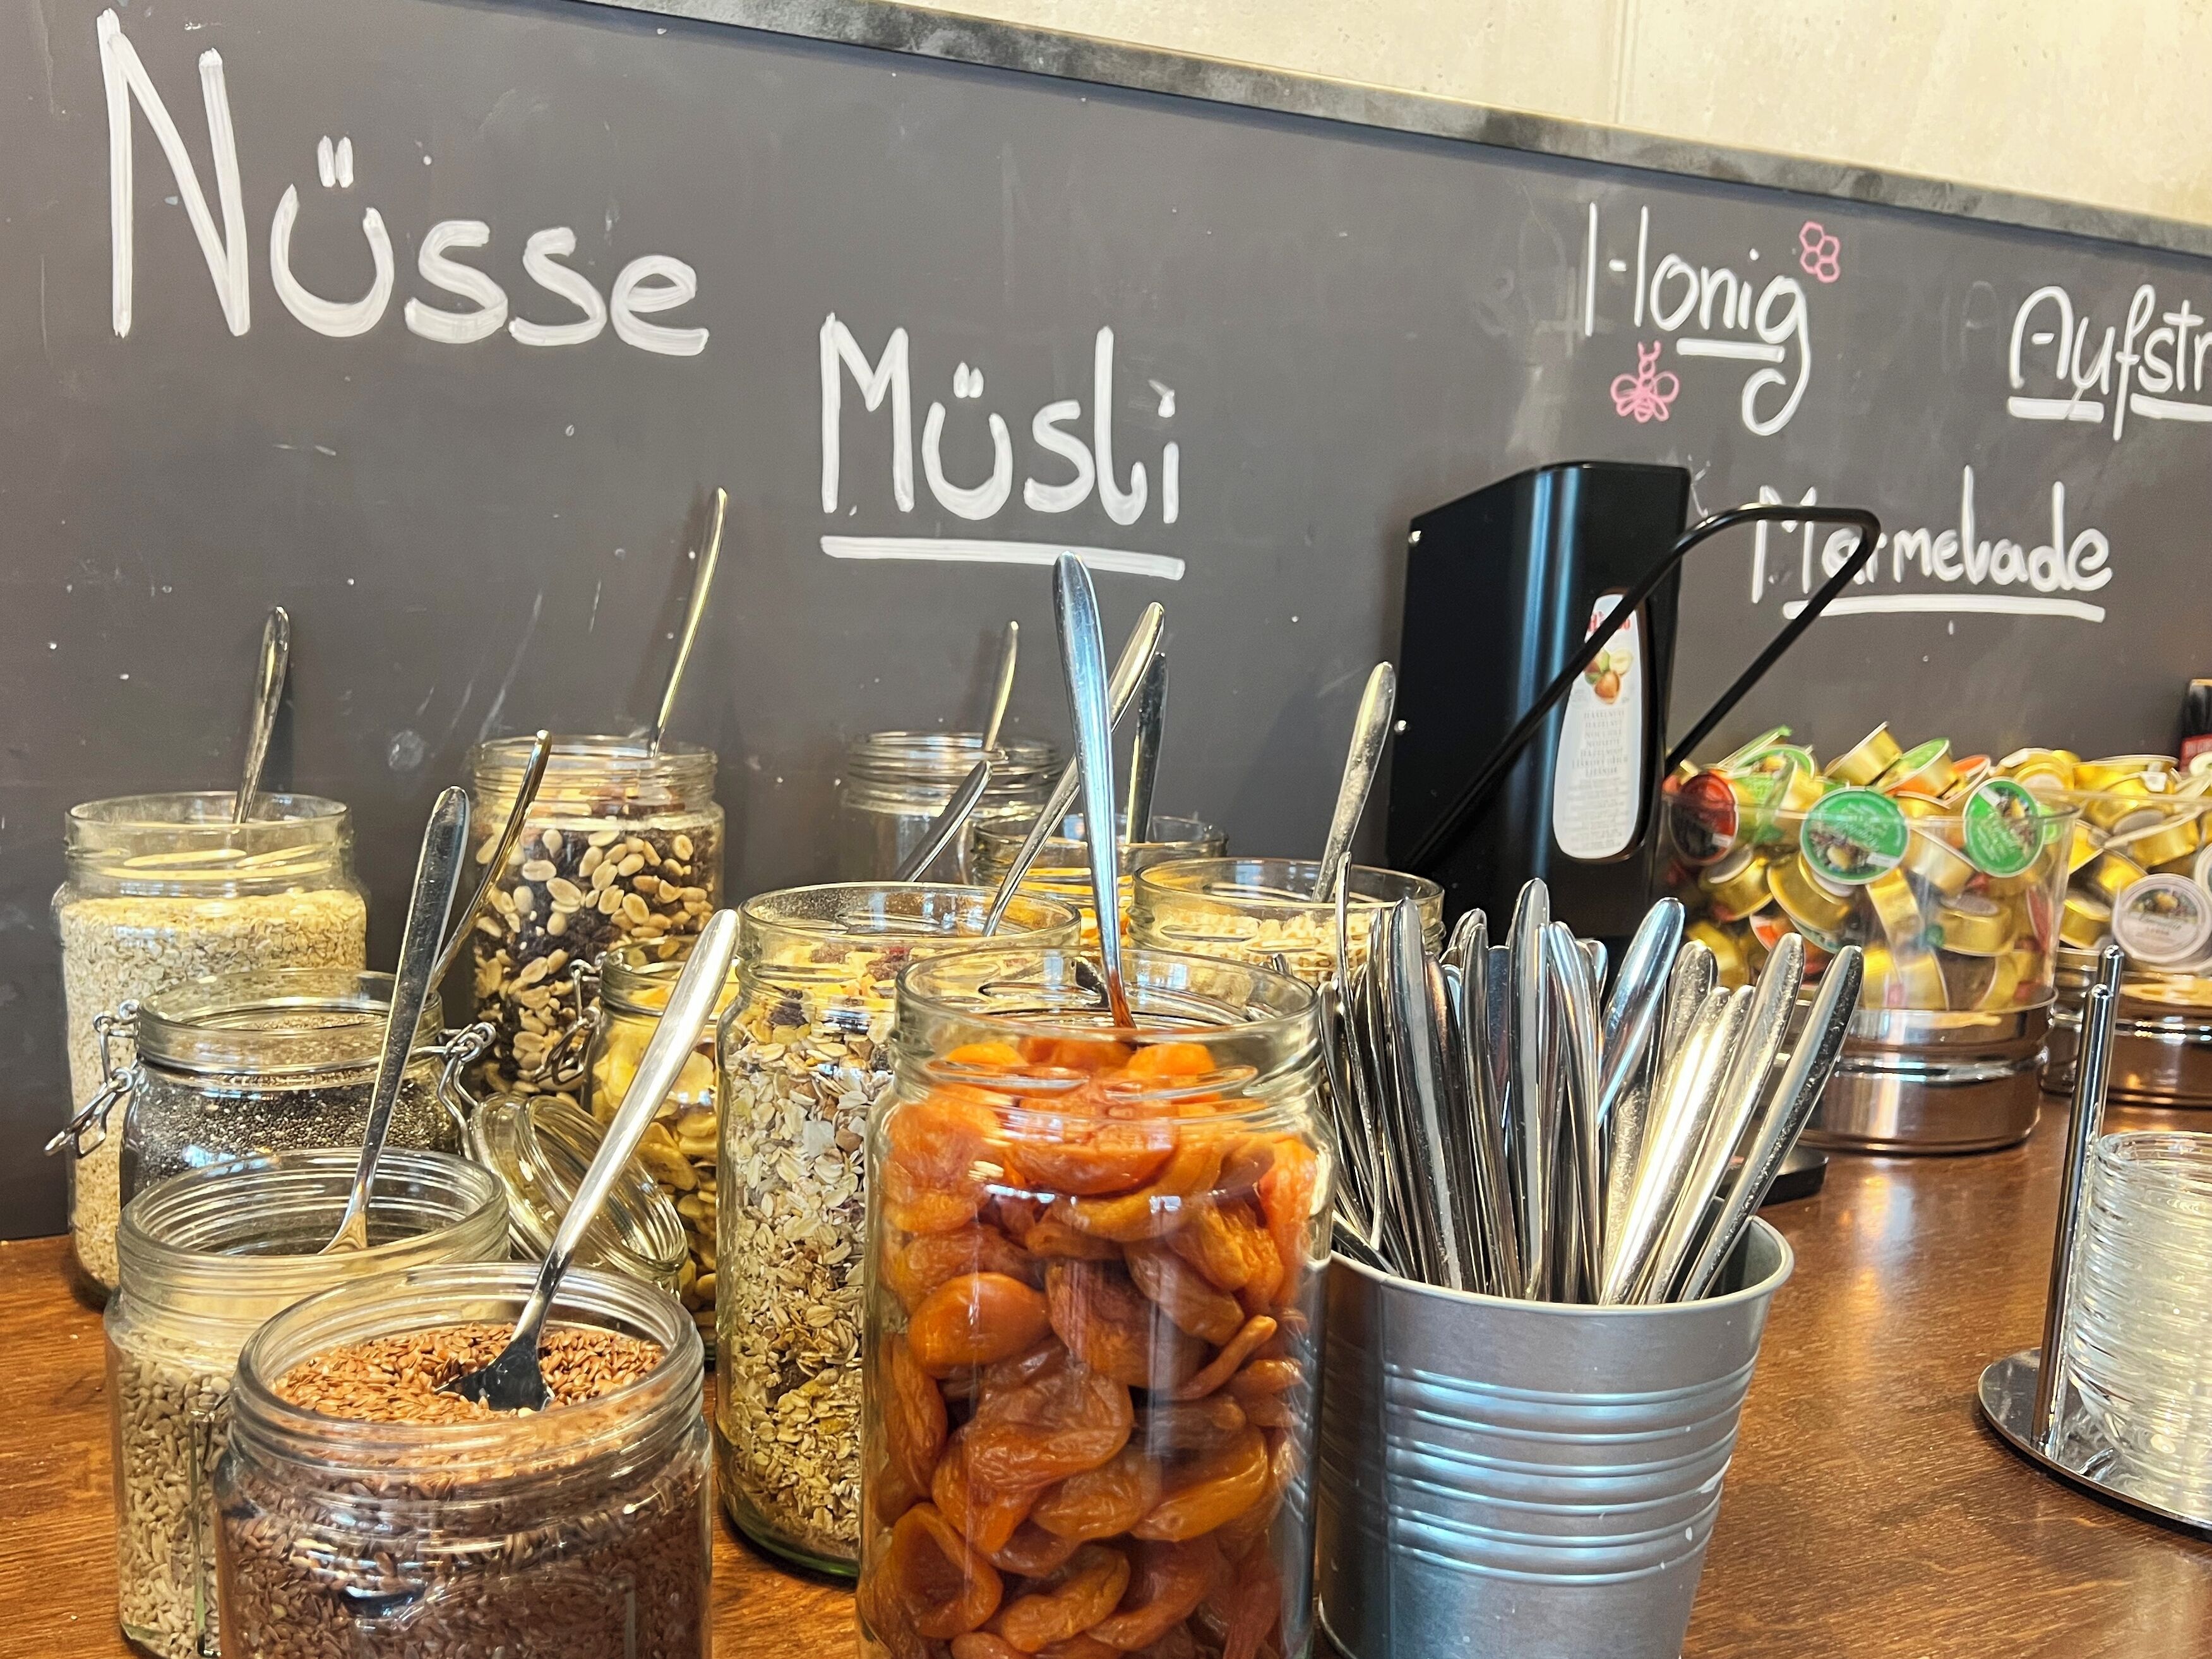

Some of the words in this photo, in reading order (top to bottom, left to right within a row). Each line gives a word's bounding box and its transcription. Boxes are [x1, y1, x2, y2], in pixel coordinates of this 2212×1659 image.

[96, 8, 709, 356] Nüsse
[820, 311, 1180, 525] Müsli
[1585, 201, 1812, 436] Honig
[2009, 284, 2212, 441] Aufstr
